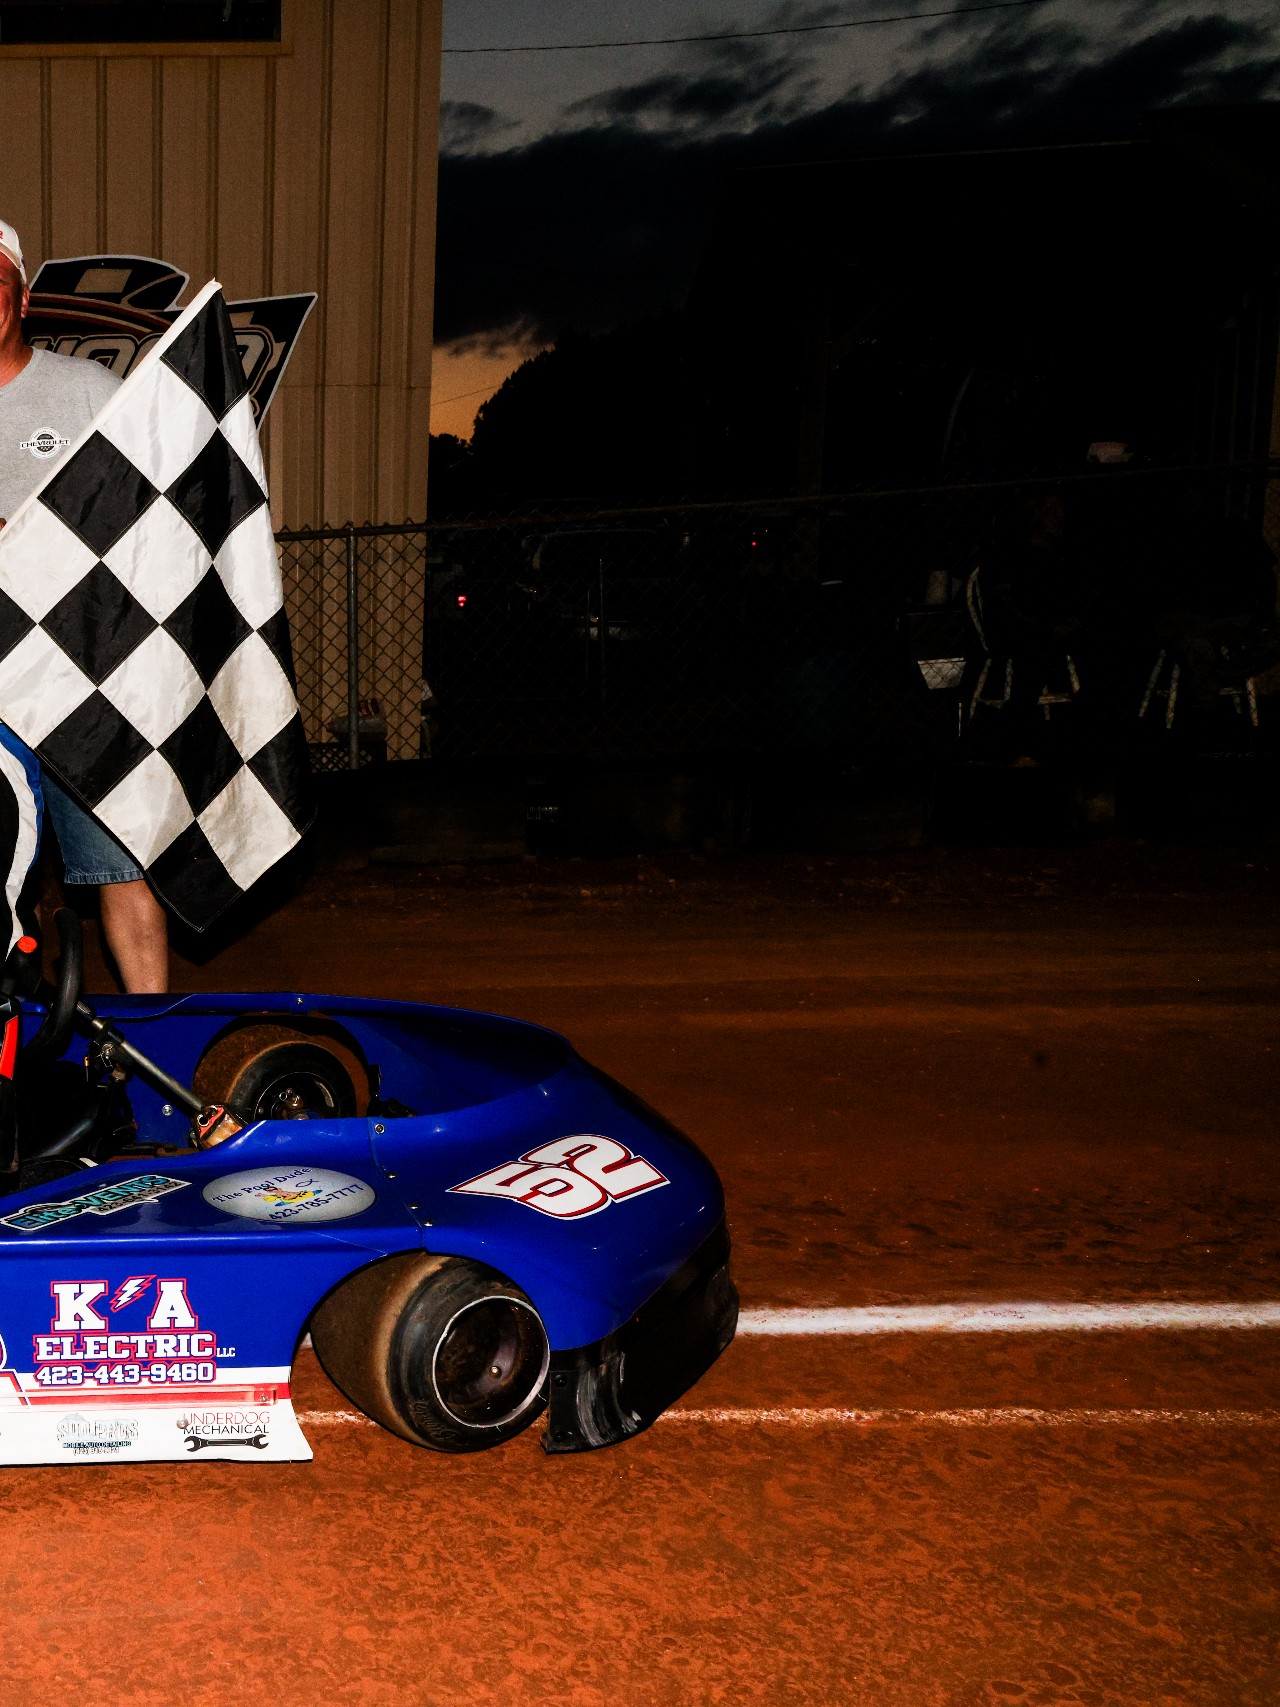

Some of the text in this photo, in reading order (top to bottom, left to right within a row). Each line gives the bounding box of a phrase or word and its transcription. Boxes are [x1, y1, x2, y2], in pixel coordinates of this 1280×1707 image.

[21, 439, 70, 448] CHEVROLET
[212, 1168, 312, 1203] The Pool Dude
[445, 1134, 670, 1220] 52
[268, 1183, 364, 1220] 423-785-7777
[33, 1331, 236, 1363] ELECTRIC LLC
[34, 1361, 216, 1386] 423-443-9460
[183, 1411, 270, 1426] UNDERDOG
[183, 1424, 270, 1434] MECHANICAL
